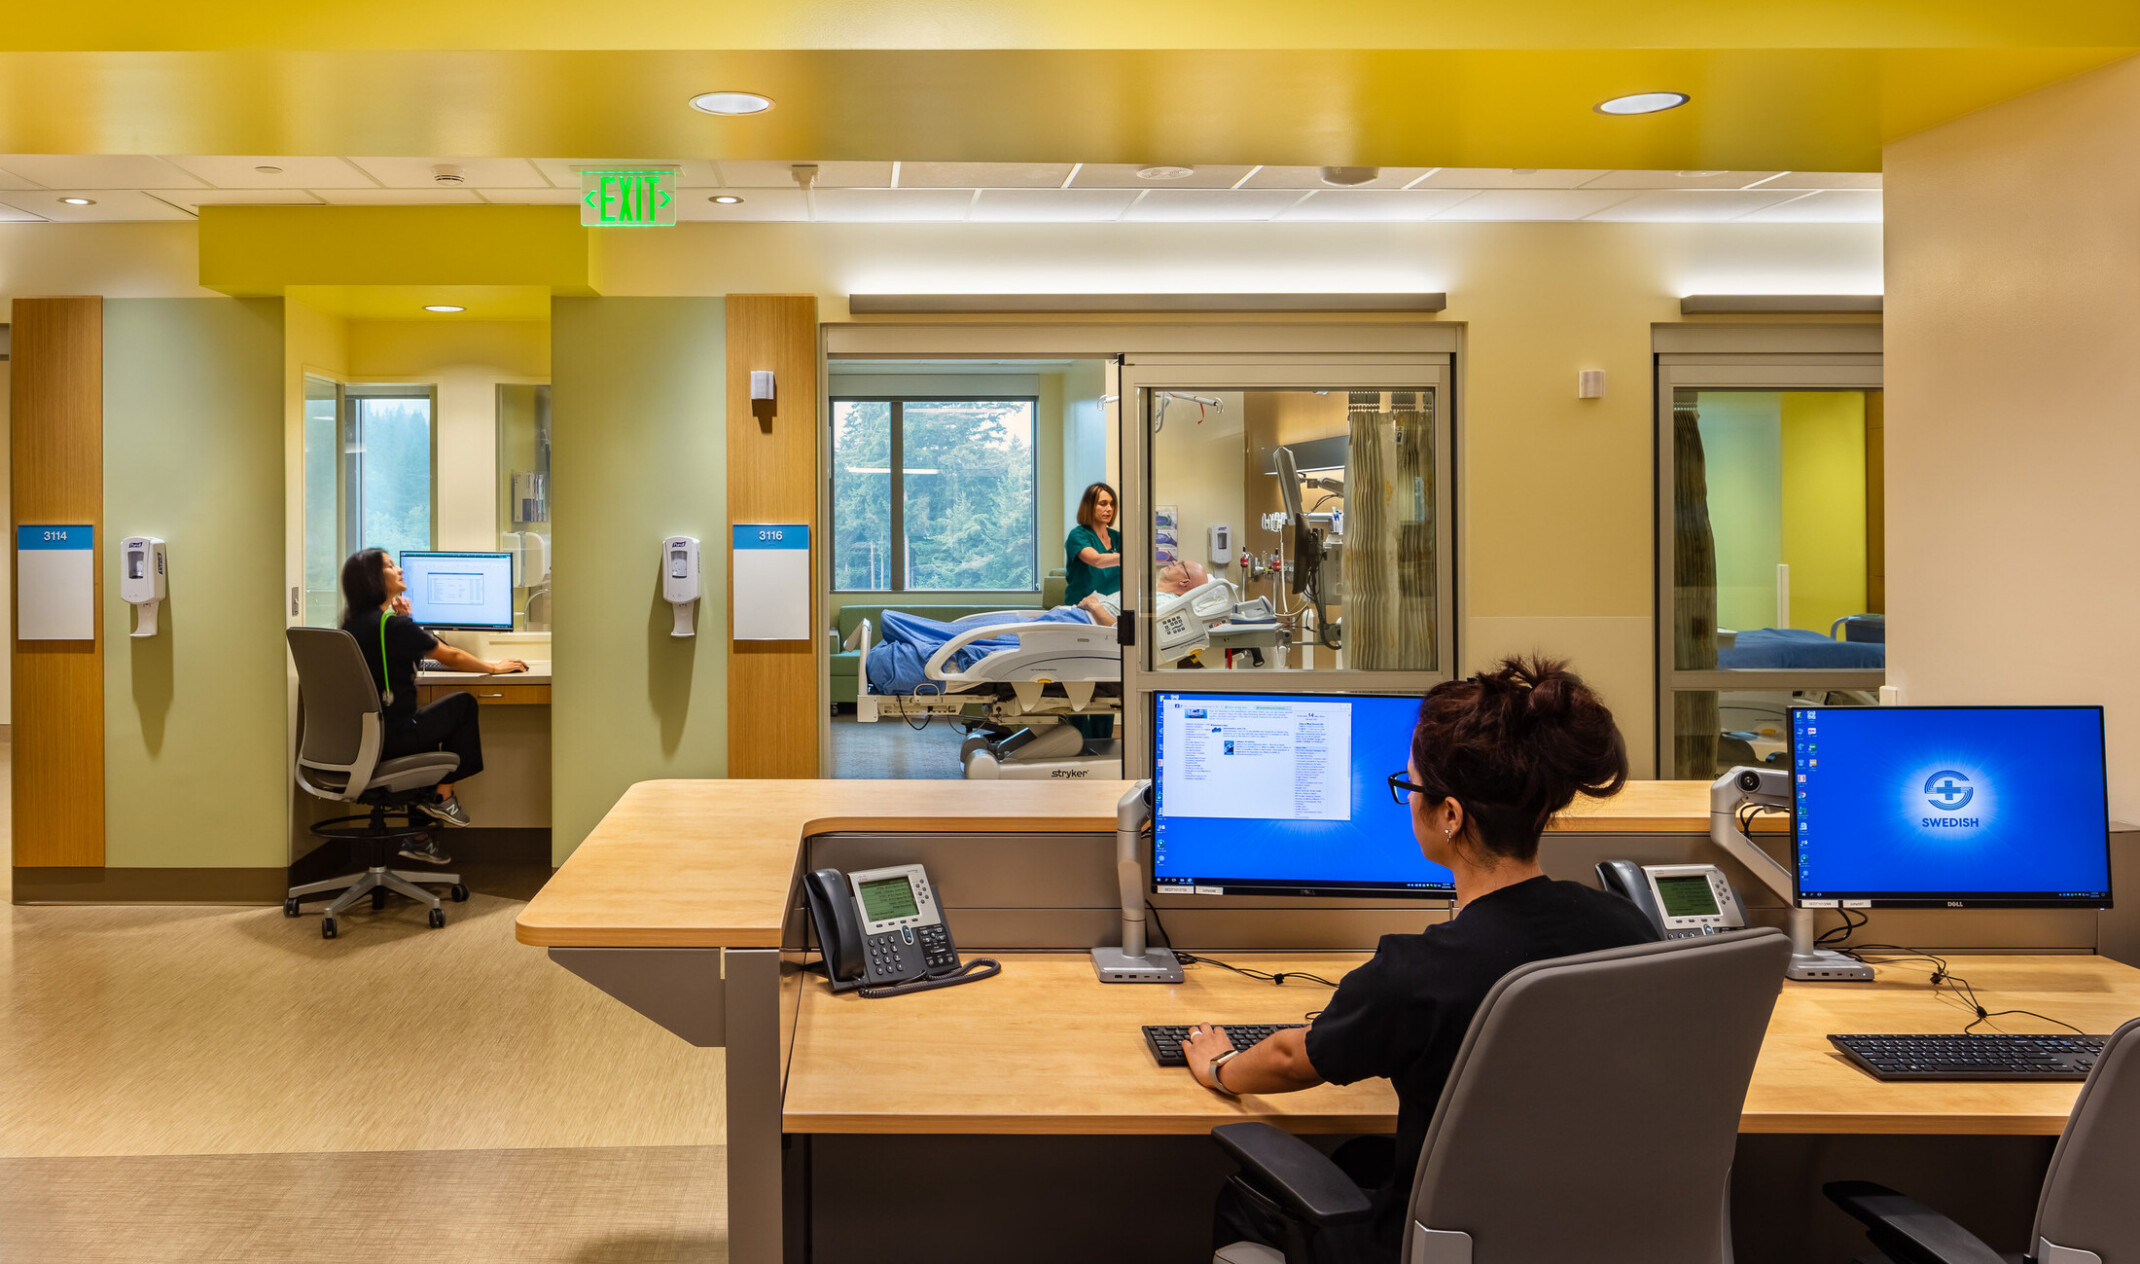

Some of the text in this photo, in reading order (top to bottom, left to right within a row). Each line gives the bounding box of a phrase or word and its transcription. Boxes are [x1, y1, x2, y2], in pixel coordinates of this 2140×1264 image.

[600, 176, 660, 222] EXIT
[43, 531, 67, 541] 3114
[759, 530, 783, 541] 3116
[1051, 769, 1088, 779] stryker
[1922, 817, 1979, 828] SWEDISH
